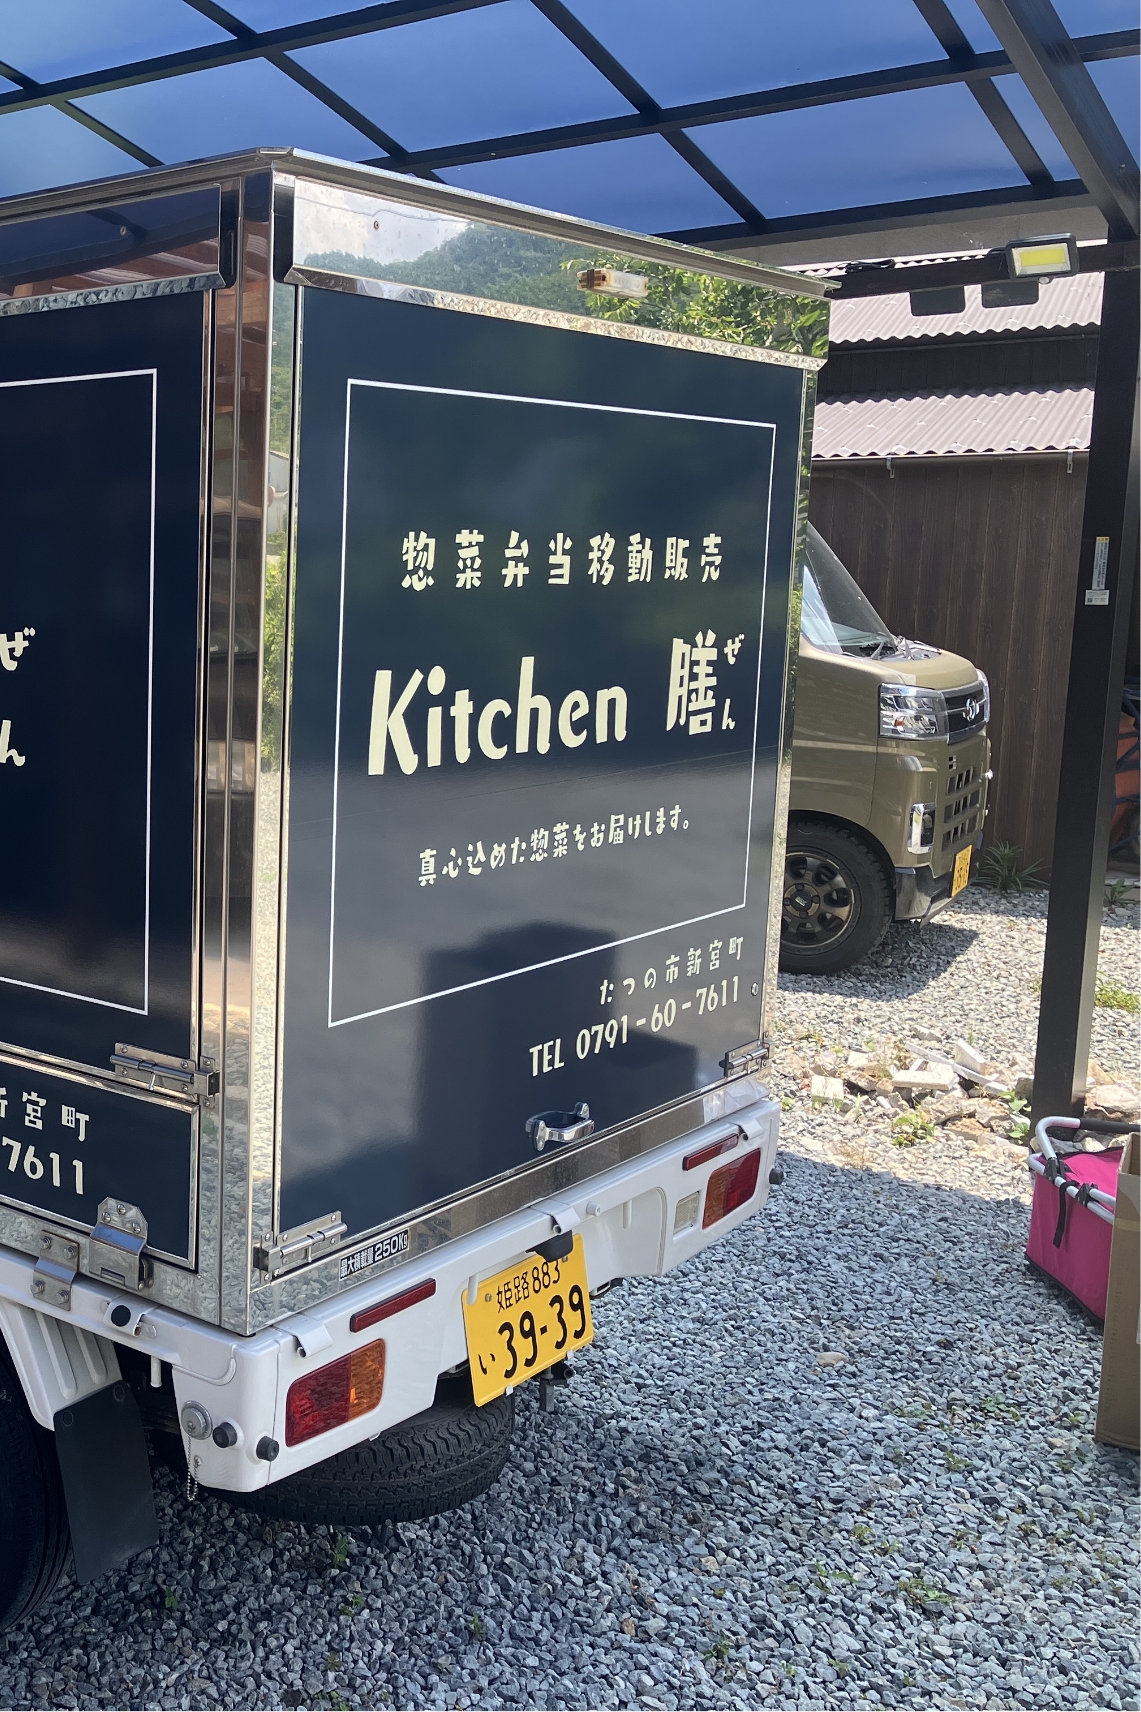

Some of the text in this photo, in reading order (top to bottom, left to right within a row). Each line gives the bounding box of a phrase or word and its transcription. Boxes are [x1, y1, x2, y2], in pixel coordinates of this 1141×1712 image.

[401, 529, 723, 592] 惣菜弁当移動販売
[367, 628, 717, 776] Kitchen 膳
[418, 804, 689, 887] 真心込めた惣菜をお届けします。
[599, 936, 744, 1005] たつの市新宮町
[529, 975, 739, 1077] TEL 0791-60-7611
[497, 1284, 587, 1379] 39-39
